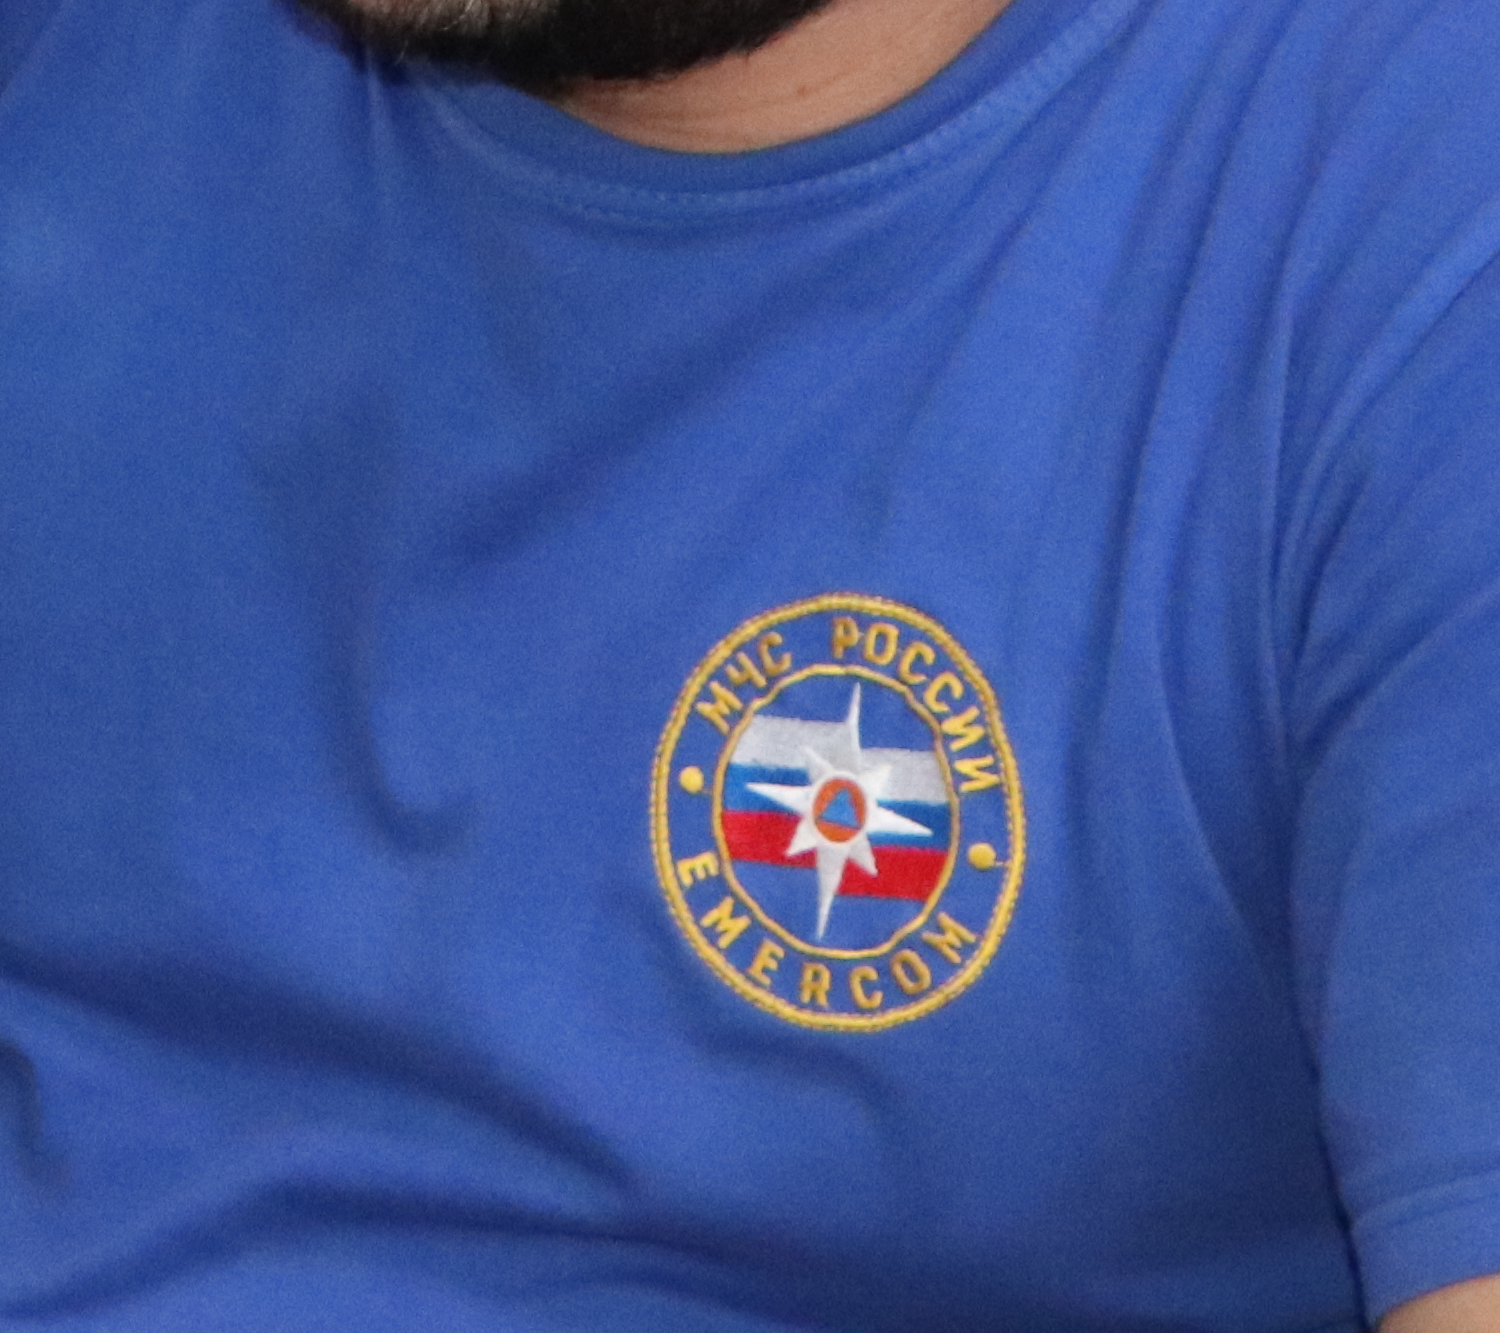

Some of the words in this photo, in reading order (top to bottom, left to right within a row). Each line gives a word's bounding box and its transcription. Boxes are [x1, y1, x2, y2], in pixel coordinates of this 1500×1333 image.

[696, 632, 792, 736] МЧС
[830, 615, 1001, 794] РОССИИ
[675, 850, 977, 1010] EMERCOM
